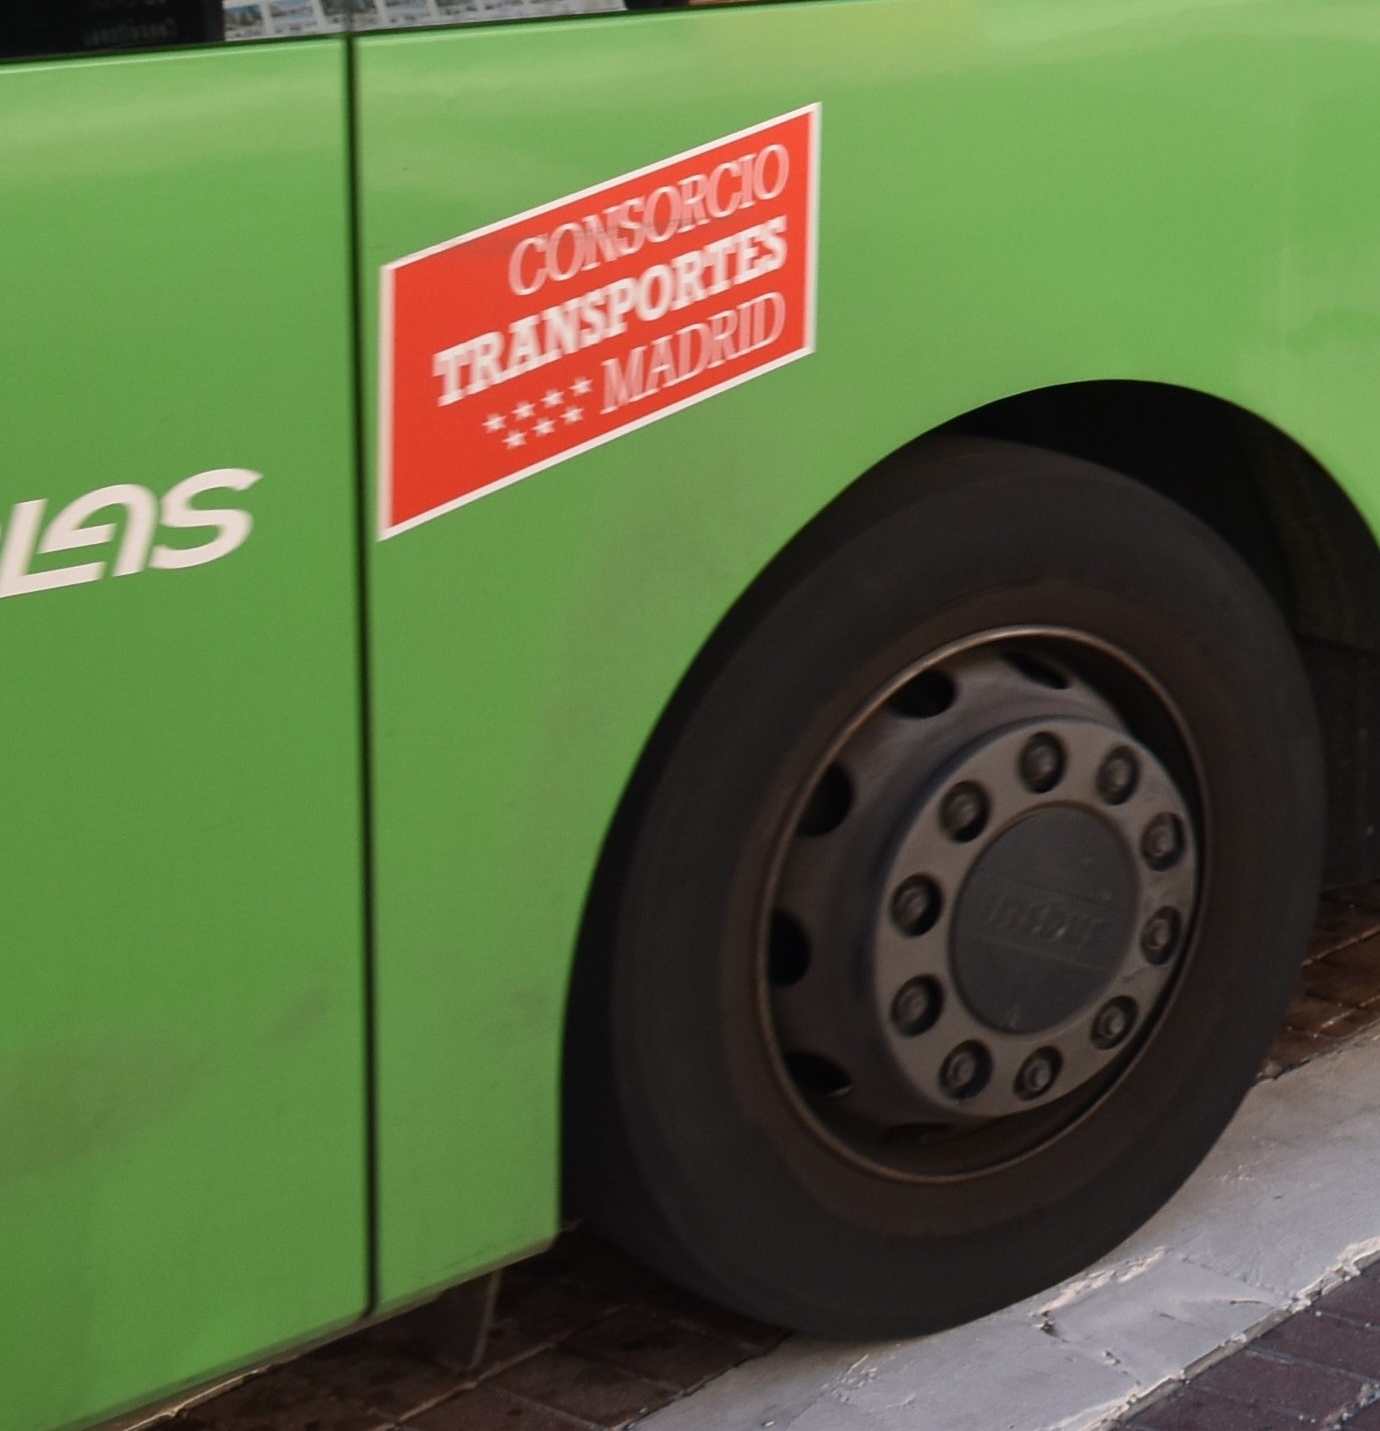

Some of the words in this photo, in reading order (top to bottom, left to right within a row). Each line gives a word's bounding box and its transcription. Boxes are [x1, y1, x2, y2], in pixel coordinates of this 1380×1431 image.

[508, 143, 790, 296] CONSORCIO
[433, 215, 788, 408] TRANSPORTES
[600, 291, 787, 415] MADRID
